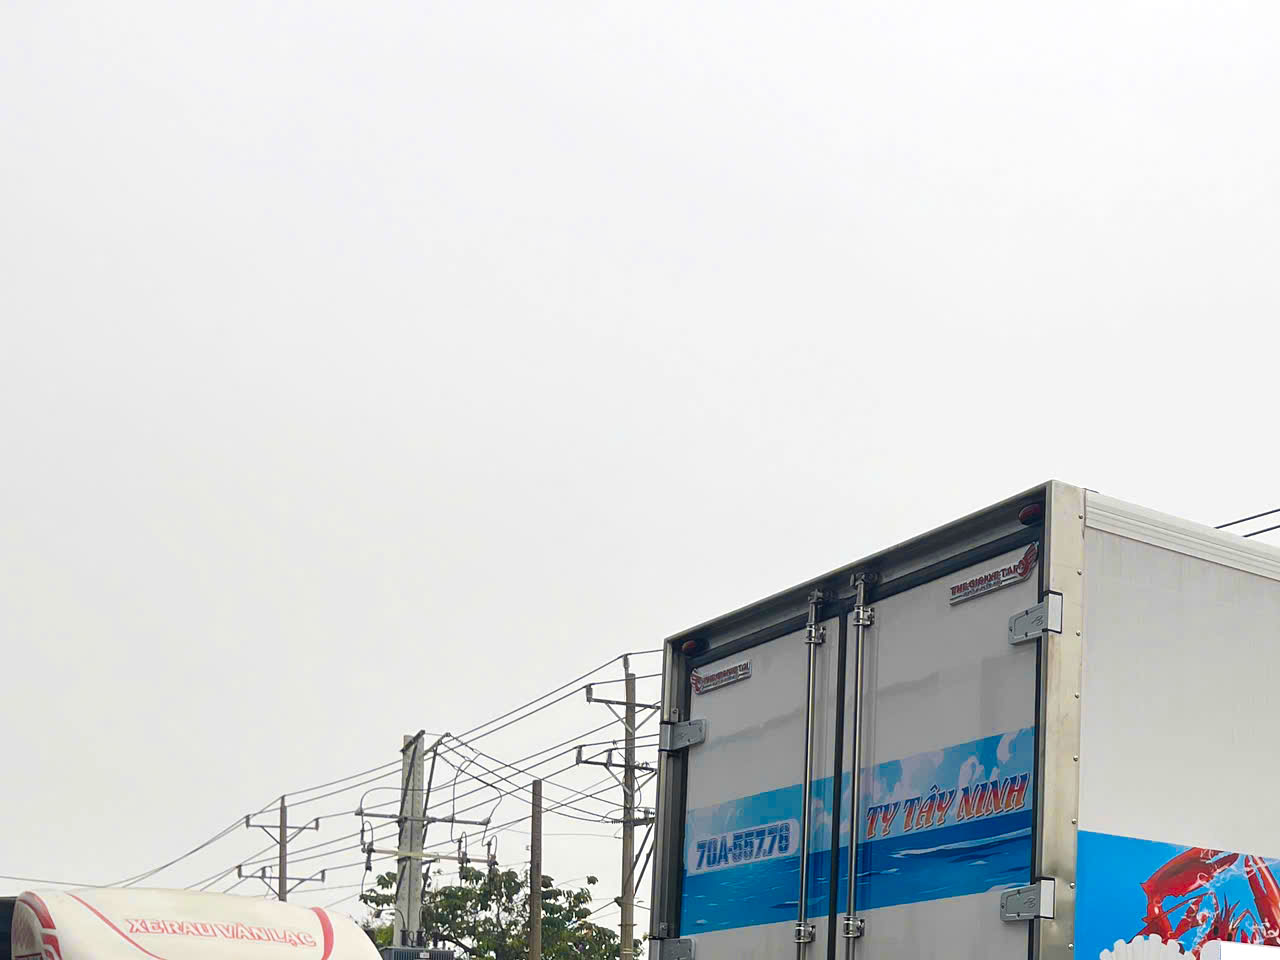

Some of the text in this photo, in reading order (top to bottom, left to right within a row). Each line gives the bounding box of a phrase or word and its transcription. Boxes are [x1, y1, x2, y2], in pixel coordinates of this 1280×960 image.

[866, 772, 1031, 840] TY TÂY NINH
